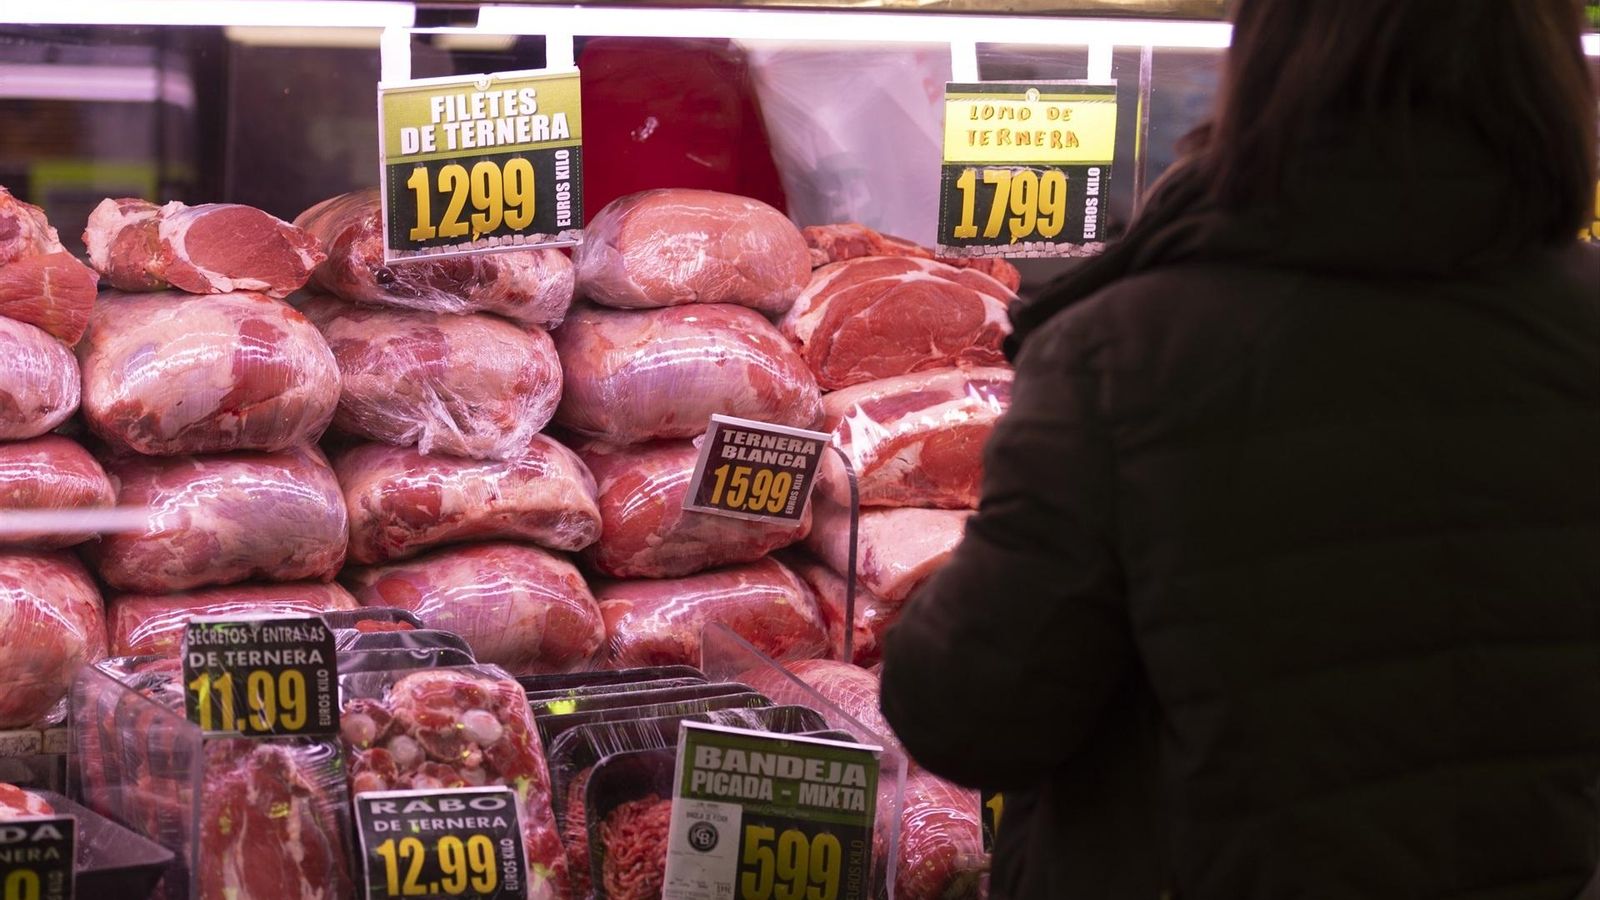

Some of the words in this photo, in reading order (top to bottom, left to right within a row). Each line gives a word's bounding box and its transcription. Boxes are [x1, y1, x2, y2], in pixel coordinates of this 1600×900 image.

[430, 88, 538, 124] FILETES
[969, 105, 1031, 121] LOMO
[1046, 106, 1073, 122] DE
[400, 125, 437, 155] DE
[443, 112, 570, 150] TERNERA
[966, 128, 1080, 150] TERNERA
[555, 149, 569, 181] KILO
[1087, 167, 1101, 196] KILO
[557, 182, 571, 228] EUROS
[1083, 197, 1098, 239] EUROS
[721, 444, 807, 469] BLANCA
[722, 429, 816, 455] TERNERA
[710, 464, 792, 513] 15,99
[785, 491, 799, 514] EUROS
[794, 474, 804, 491] KILO
[188, 627, 248, 646] SECRETOS
[189, 651, 217, 668] DE
[224, 649, 324, 667] TERNERA
[316, 669, 329, 691] KILO
[189, 669, 307, 732] 11.99
[318, 693, 331, 726] EUROS
[694, 745, 867, 787] BANDEJA
[370, 797, 507, 815] RABO
[690, 769, 773, 801] PICADA
[798, 782, 865, 812] MIXTA
[373, 820, 402, 832] DE
[408, 816, 508, 832] TERNERA
[500, 838, 514, 859] KILO
[376, 834, 498, 897] 12.99
[503, 861, 518, 891] EUROS
